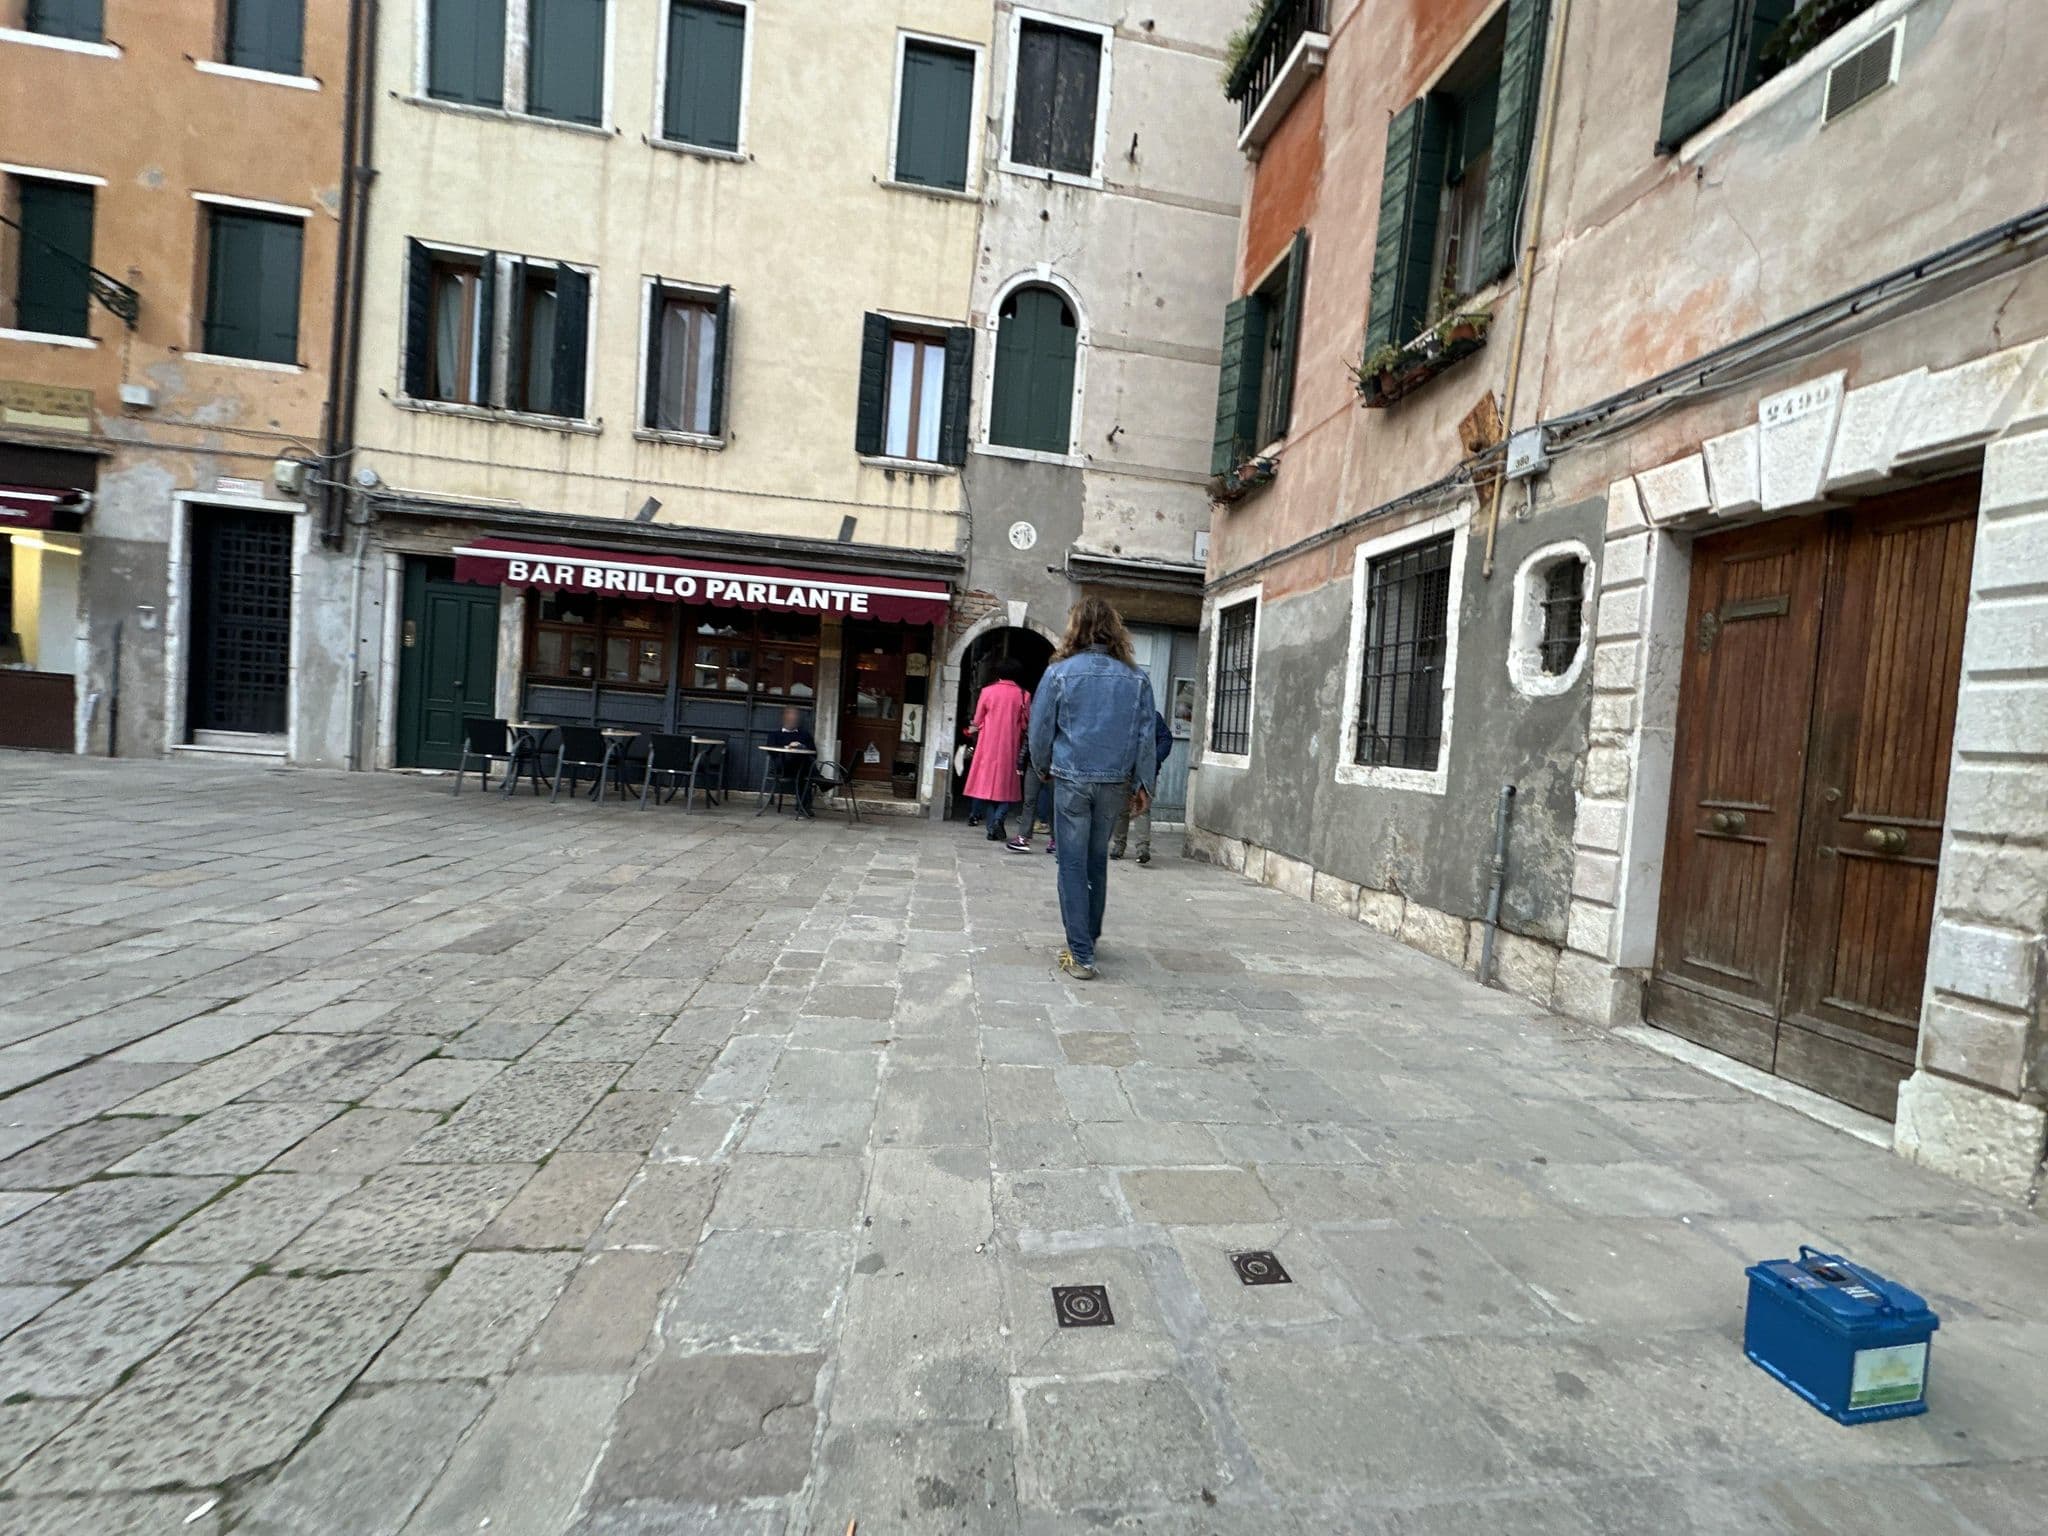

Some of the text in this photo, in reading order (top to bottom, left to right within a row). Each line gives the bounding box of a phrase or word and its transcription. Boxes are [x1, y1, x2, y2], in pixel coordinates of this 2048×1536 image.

[507, 559, 869, 613] BAR BRILLO PARLANTE
